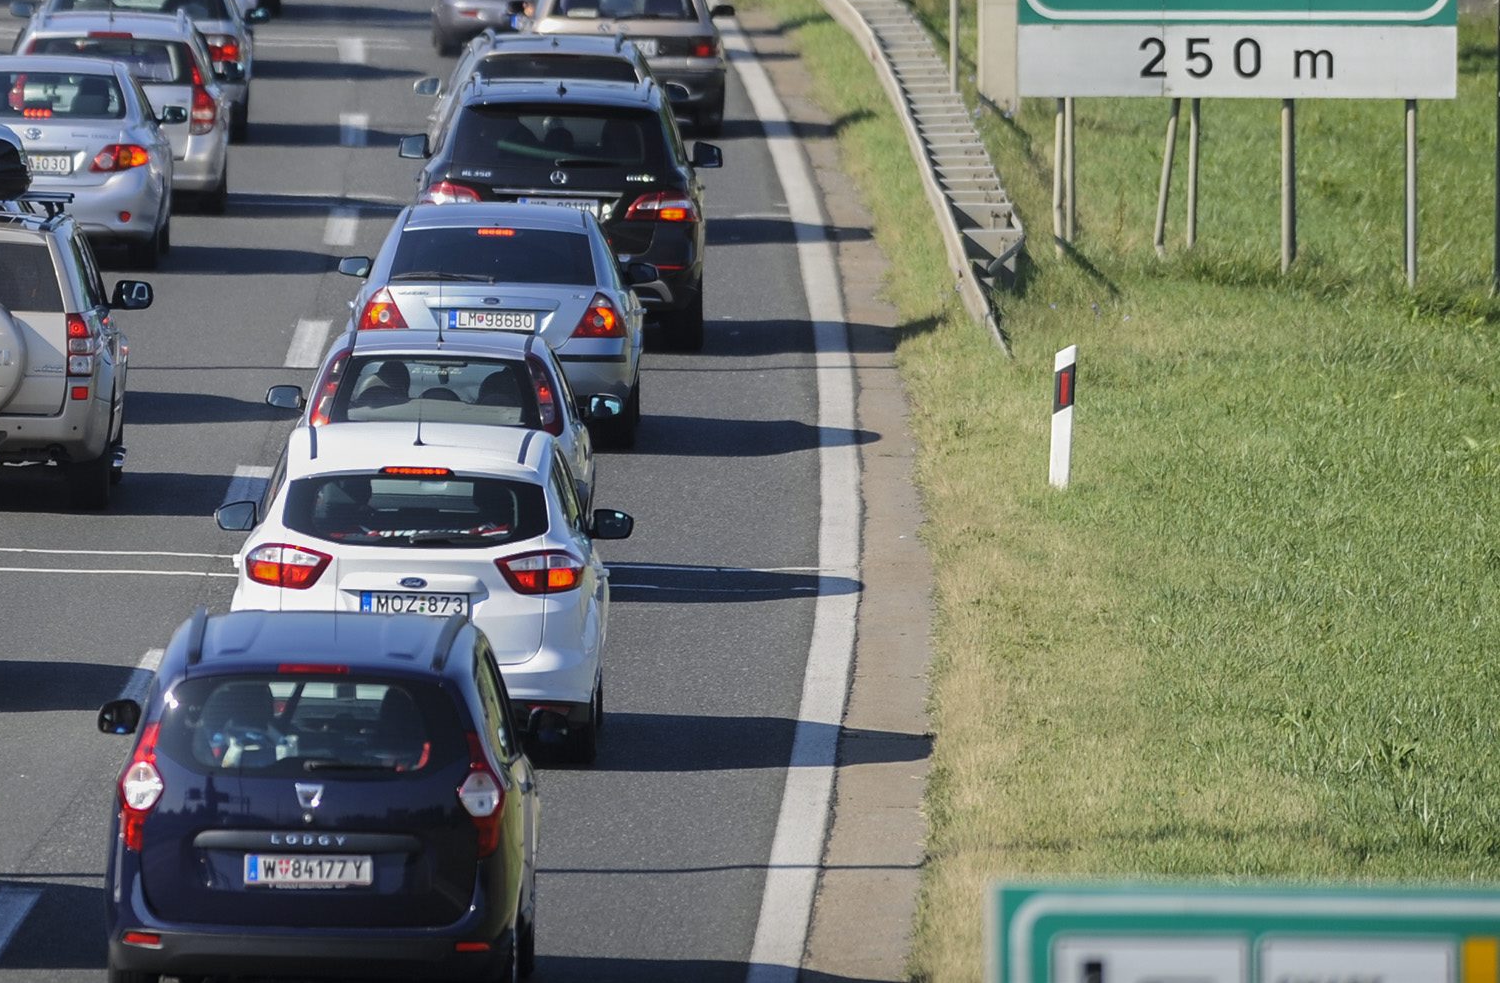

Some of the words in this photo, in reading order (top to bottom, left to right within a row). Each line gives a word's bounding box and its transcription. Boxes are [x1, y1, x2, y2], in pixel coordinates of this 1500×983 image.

[1294, 47, 1335, 79] m
[458, 313, 477, 327] LM
[270, 834, 346, 846] LODGY
[263, 860, 276, 878] W
